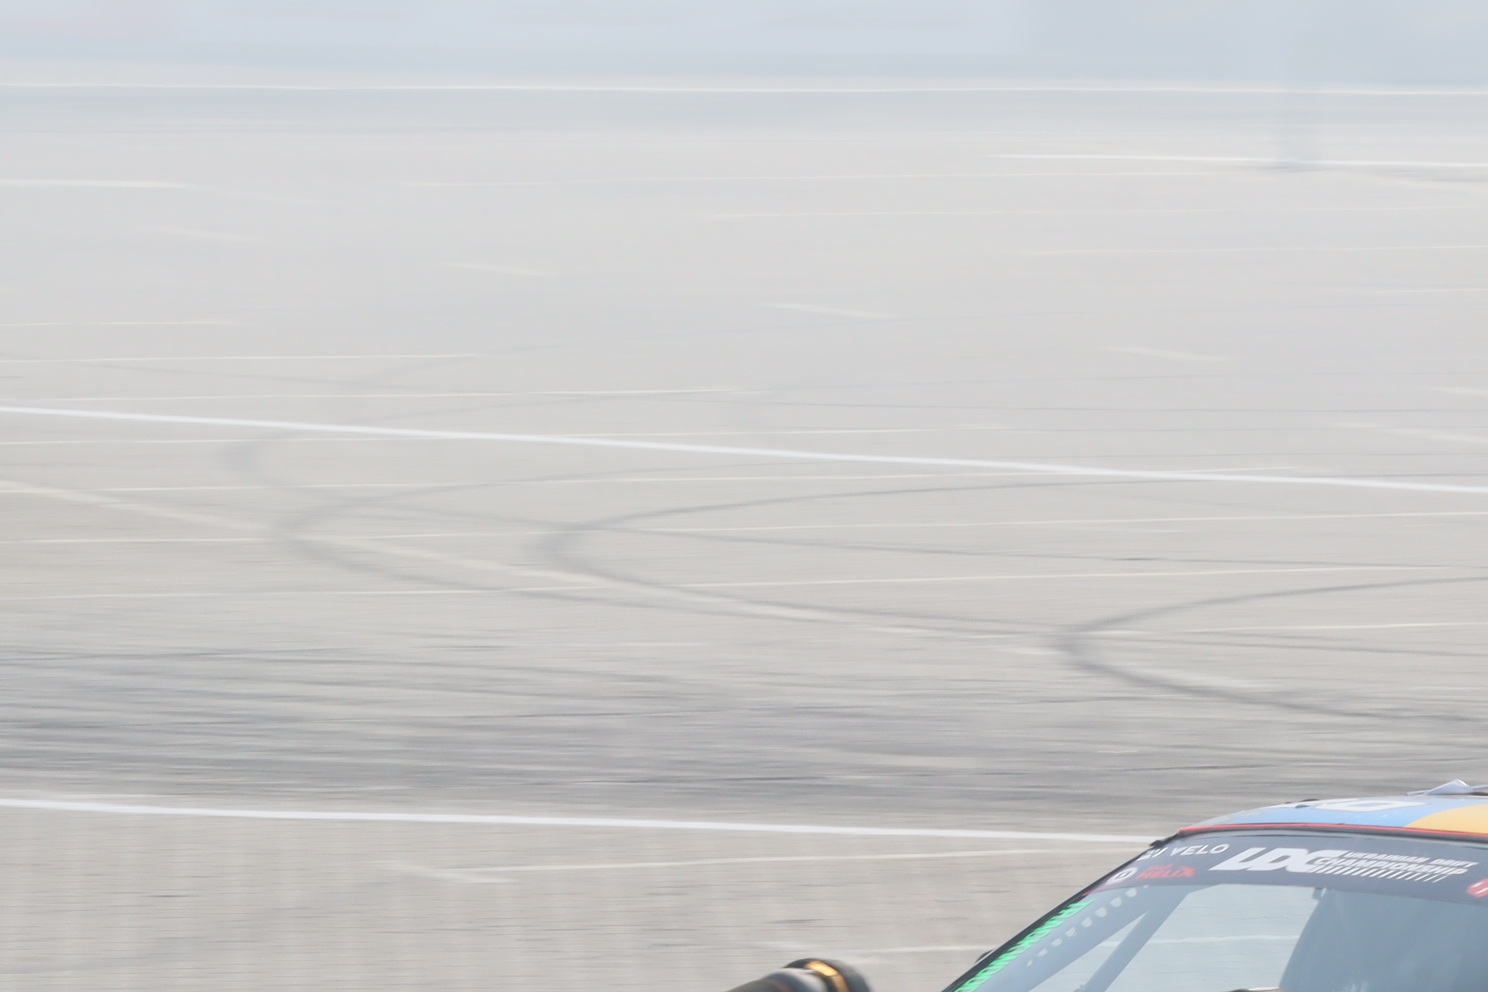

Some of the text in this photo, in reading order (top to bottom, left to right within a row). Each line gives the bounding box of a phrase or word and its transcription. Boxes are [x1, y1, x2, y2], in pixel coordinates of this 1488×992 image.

[1170, 843, 1229, 857] VELO
[1314, 857, 1469, 875] CHAMPIONSHIP
[1345, 851, 1479, 868] UKRAINIAN DRIFT
